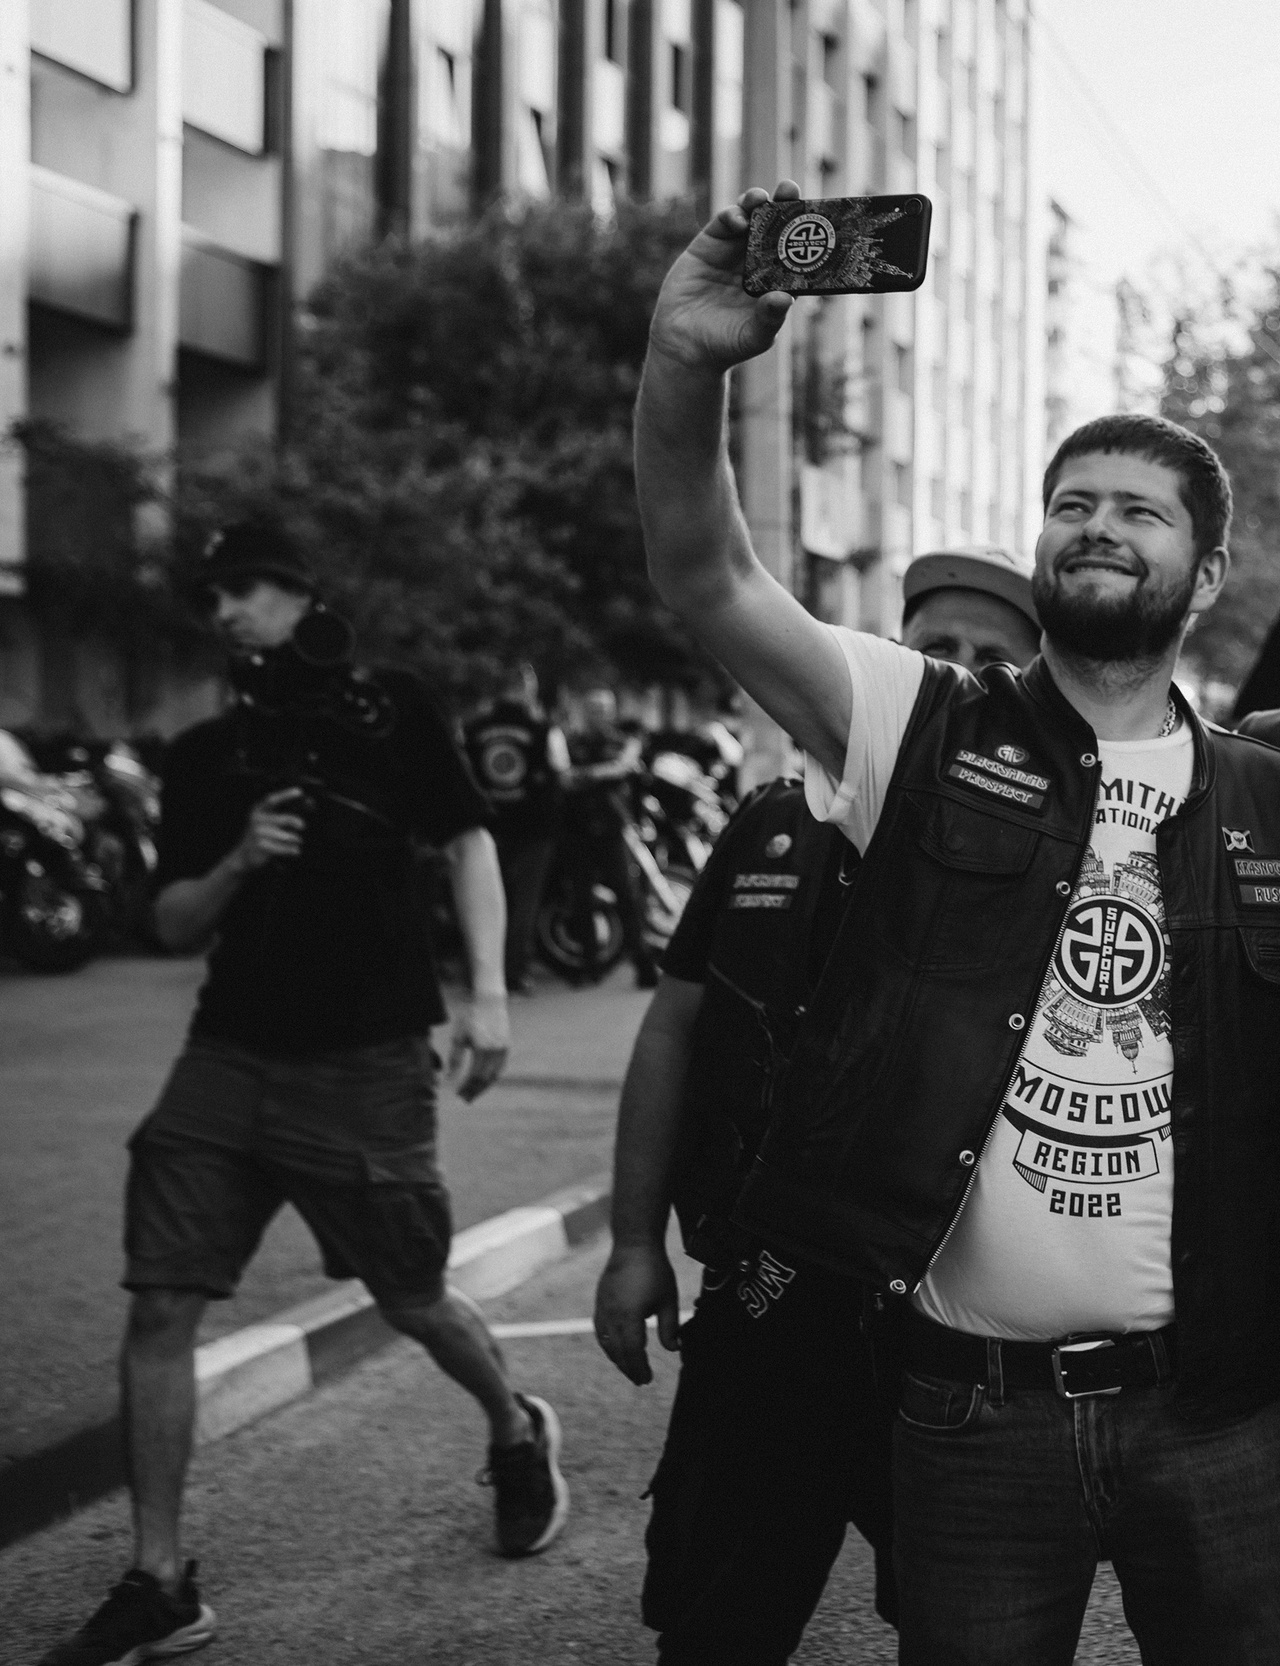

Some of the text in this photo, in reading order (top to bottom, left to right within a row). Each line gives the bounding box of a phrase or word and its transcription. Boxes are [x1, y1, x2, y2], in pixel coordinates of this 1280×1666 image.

[956, 750, 1048, 790] BLACKSMITHS
[958, 768, 1033, 803] PROSPECT
[1099, 907, 1118, 996] SUPPORT
[1014, 1064, 1171, 1125] MOSCOW
[1033, 1141, 1141, 1177] REGION
[1049, 1188, 1122, 1218] 2022
[737, 1249, 797, 1319] MC
